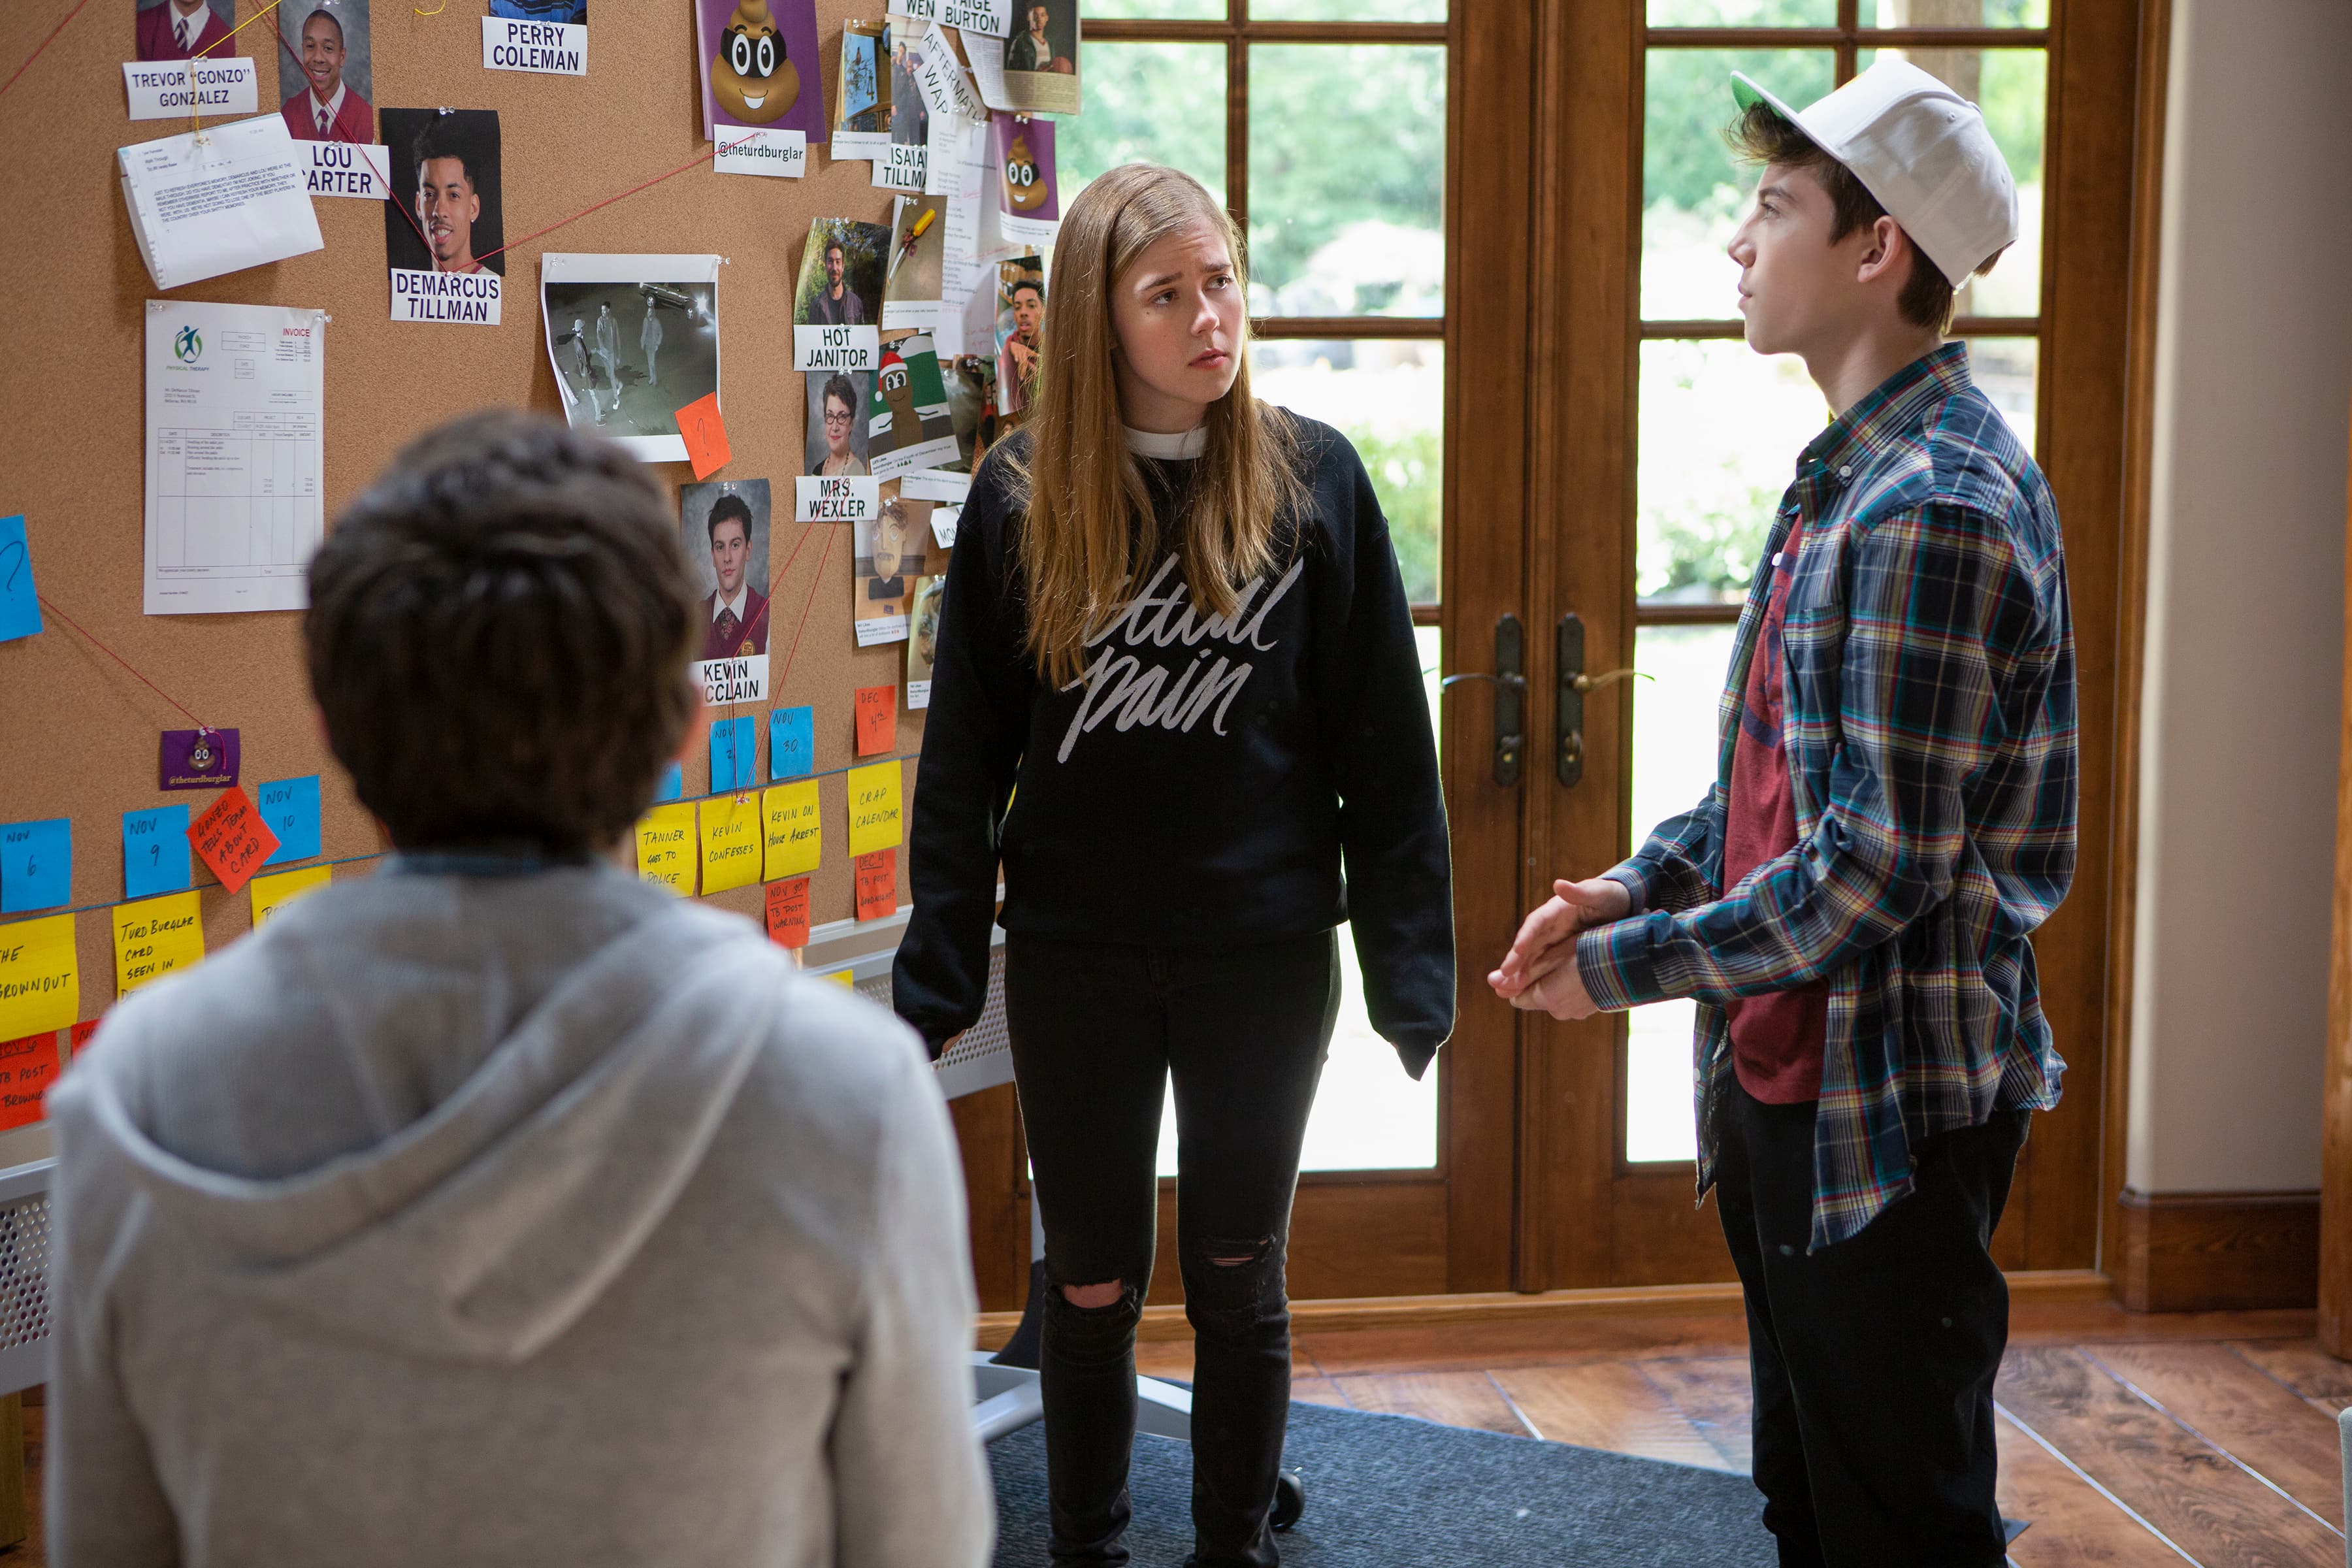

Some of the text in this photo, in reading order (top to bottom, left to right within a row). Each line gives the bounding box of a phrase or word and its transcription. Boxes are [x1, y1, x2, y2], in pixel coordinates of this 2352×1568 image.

[945, 7, 1000, 33] BURTON
[508, 23, 564, 47] PERRY
[493, 45, 579, 71] COLEMAN
[132, 72, 186, 88] TREVOR
[159, 90, 229, 106] GONZALEZ
[313, 145, 351, 168] LOU
[717, 140, 804, 162] @theturdburglar
[891, 147, 927, 168] ISAIA
[302, 169, 371, 193] ARTER
[397, 273, 499, 299] DEMARCUS
[408, 298, 487, 321] TILLMAN
[283, 328, 310, 337] INVOICE
[823, 329, 851, 346] HOT
[807, 349, 868, 367] JANITOR
[697, 417, 710, 457] ?
[820, 480, 855, 497] MRS.
[809, 500, 865, 518] WEXLER
[704, 660, 747, 681] KEVIN
[704, 679, 759, 703] CCLAIN
[861, 692, 879, 704] DEC
[1058, 645, 1253, 764] pain
[773, 711, 794, 725] NOV
[783, 739, 798, 752] 30
[169, 774, 232, 786] @theturdburglar
[266, 786, 292, 805] NOV
[859, 787, 887, 806] CRAP
[221, 805, 247, 830] TEAM
[283, 815, 295, 831] 10
[771, 805, 814, 824] KEVIN ON
[856, 808, 899, 828] CALENDAR
[6, 830, 30, 843] NOV
[130, 819, 157, 836] NOV
[712, 821, 742, 841] KEVIN
[220, 822, 248, 864] ABOUT
[644, 830, 685, 846] TANNER
[768, 827, 819, 848] HOUSE ARREST
[150, 844, 161, 866] 9
[231, 837, 259, 873] CARD
[666, 851, 676, 861] TO
[710, 844, 754, 863] CONFESSES
[859, 854, 874, 868] DEC
[27, 854, 37, 876] 6
[647, 872, 680, 885] POLICE
[873, 873, 889, 885] POST
[770, 886, 788, 898] NOV
[770, 904, 804, 917] TB POST
[121, 916, 194, 942] TURD BURGLAR
[774, 915, 805, 930] WARNING
[125, 945, 154, 962] CARD
[127, 958, 174, 980] SEEN IN
[20, 1064, 49, 1082] POST
